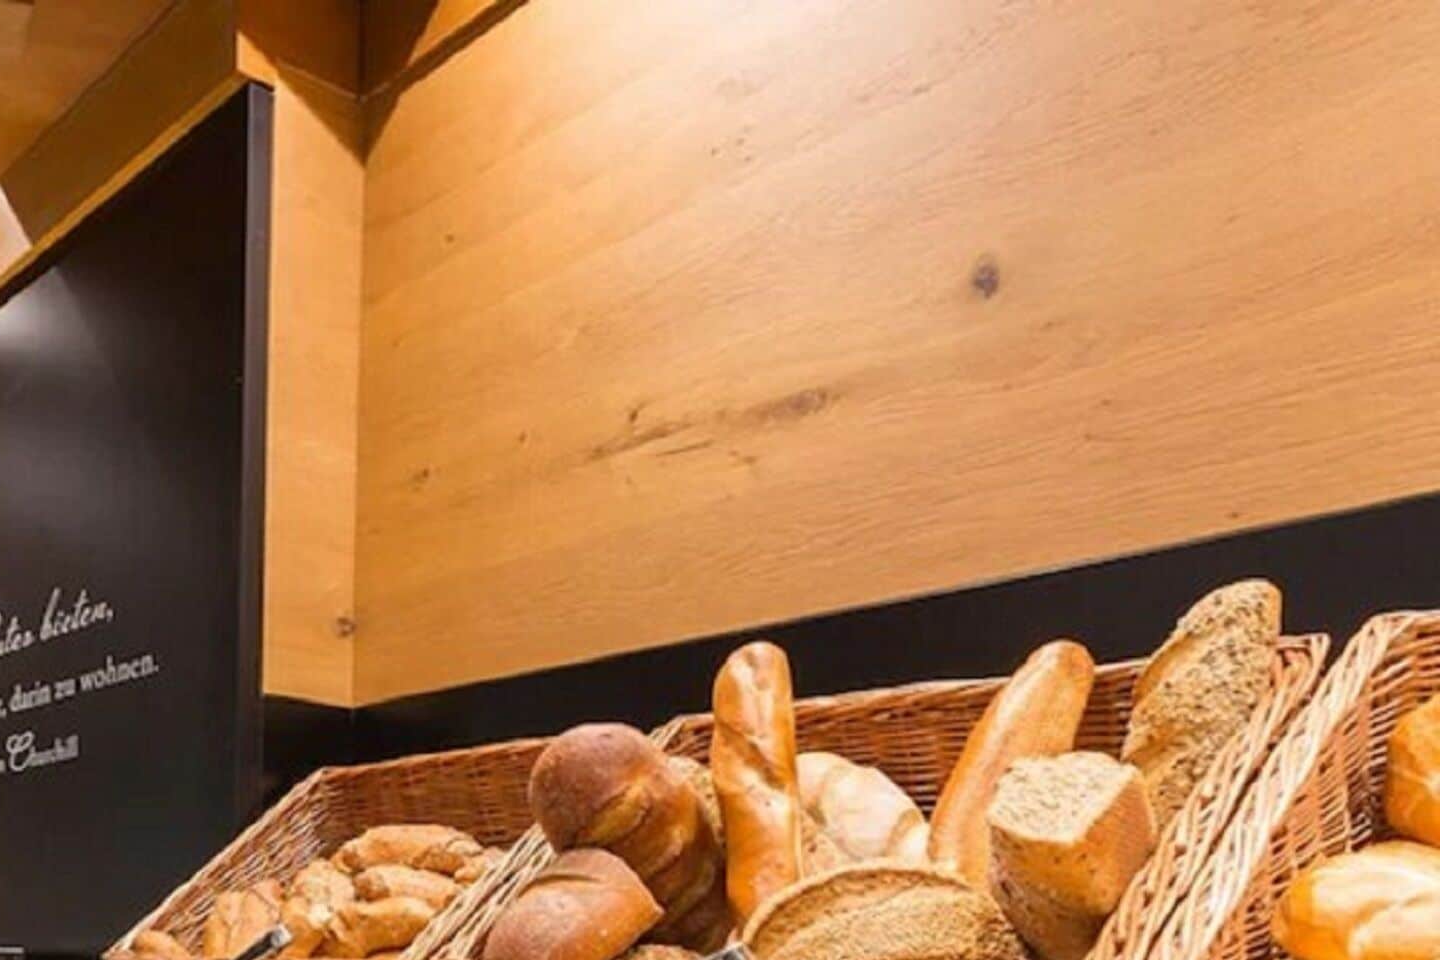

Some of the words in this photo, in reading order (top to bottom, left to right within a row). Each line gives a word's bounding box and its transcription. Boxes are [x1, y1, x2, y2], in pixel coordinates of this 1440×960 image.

[39, 587, 114, 642] bieten,
[8, 684, 52, 713] darin
[54, 678, 77, 700] zu
[79, 655, 160, 692] wohnen.
